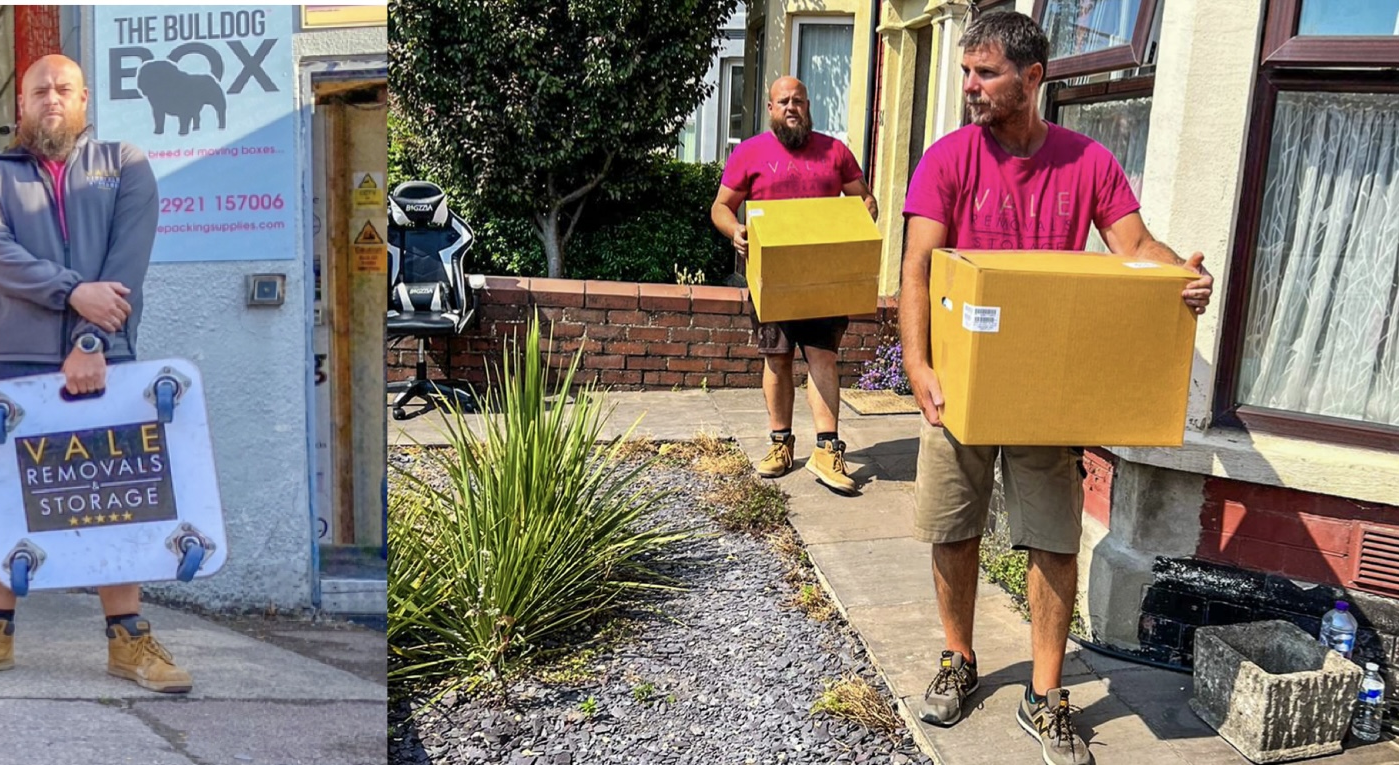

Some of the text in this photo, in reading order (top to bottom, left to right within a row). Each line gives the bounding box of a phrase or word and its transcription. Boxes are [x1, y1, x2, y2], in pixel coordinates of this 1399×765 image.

[114, 9, 265, 44] THE BULLDOG
[108, 38, 280, 100] BOX
[148, 149, 181, 158] breed
[184, 148, 194, 157] of
[198, 146, 238, 157] moving
[160, 193, 285, 213] 2921 157006
[974, 188, 1070, 218] VALE
[972, 214, 1072, 233] REMOVALS
[22, 423, 162, 466] VALE
[27, 454, 164, 486] REMOVALS
[40, 487, 159, 516] STORAGE
